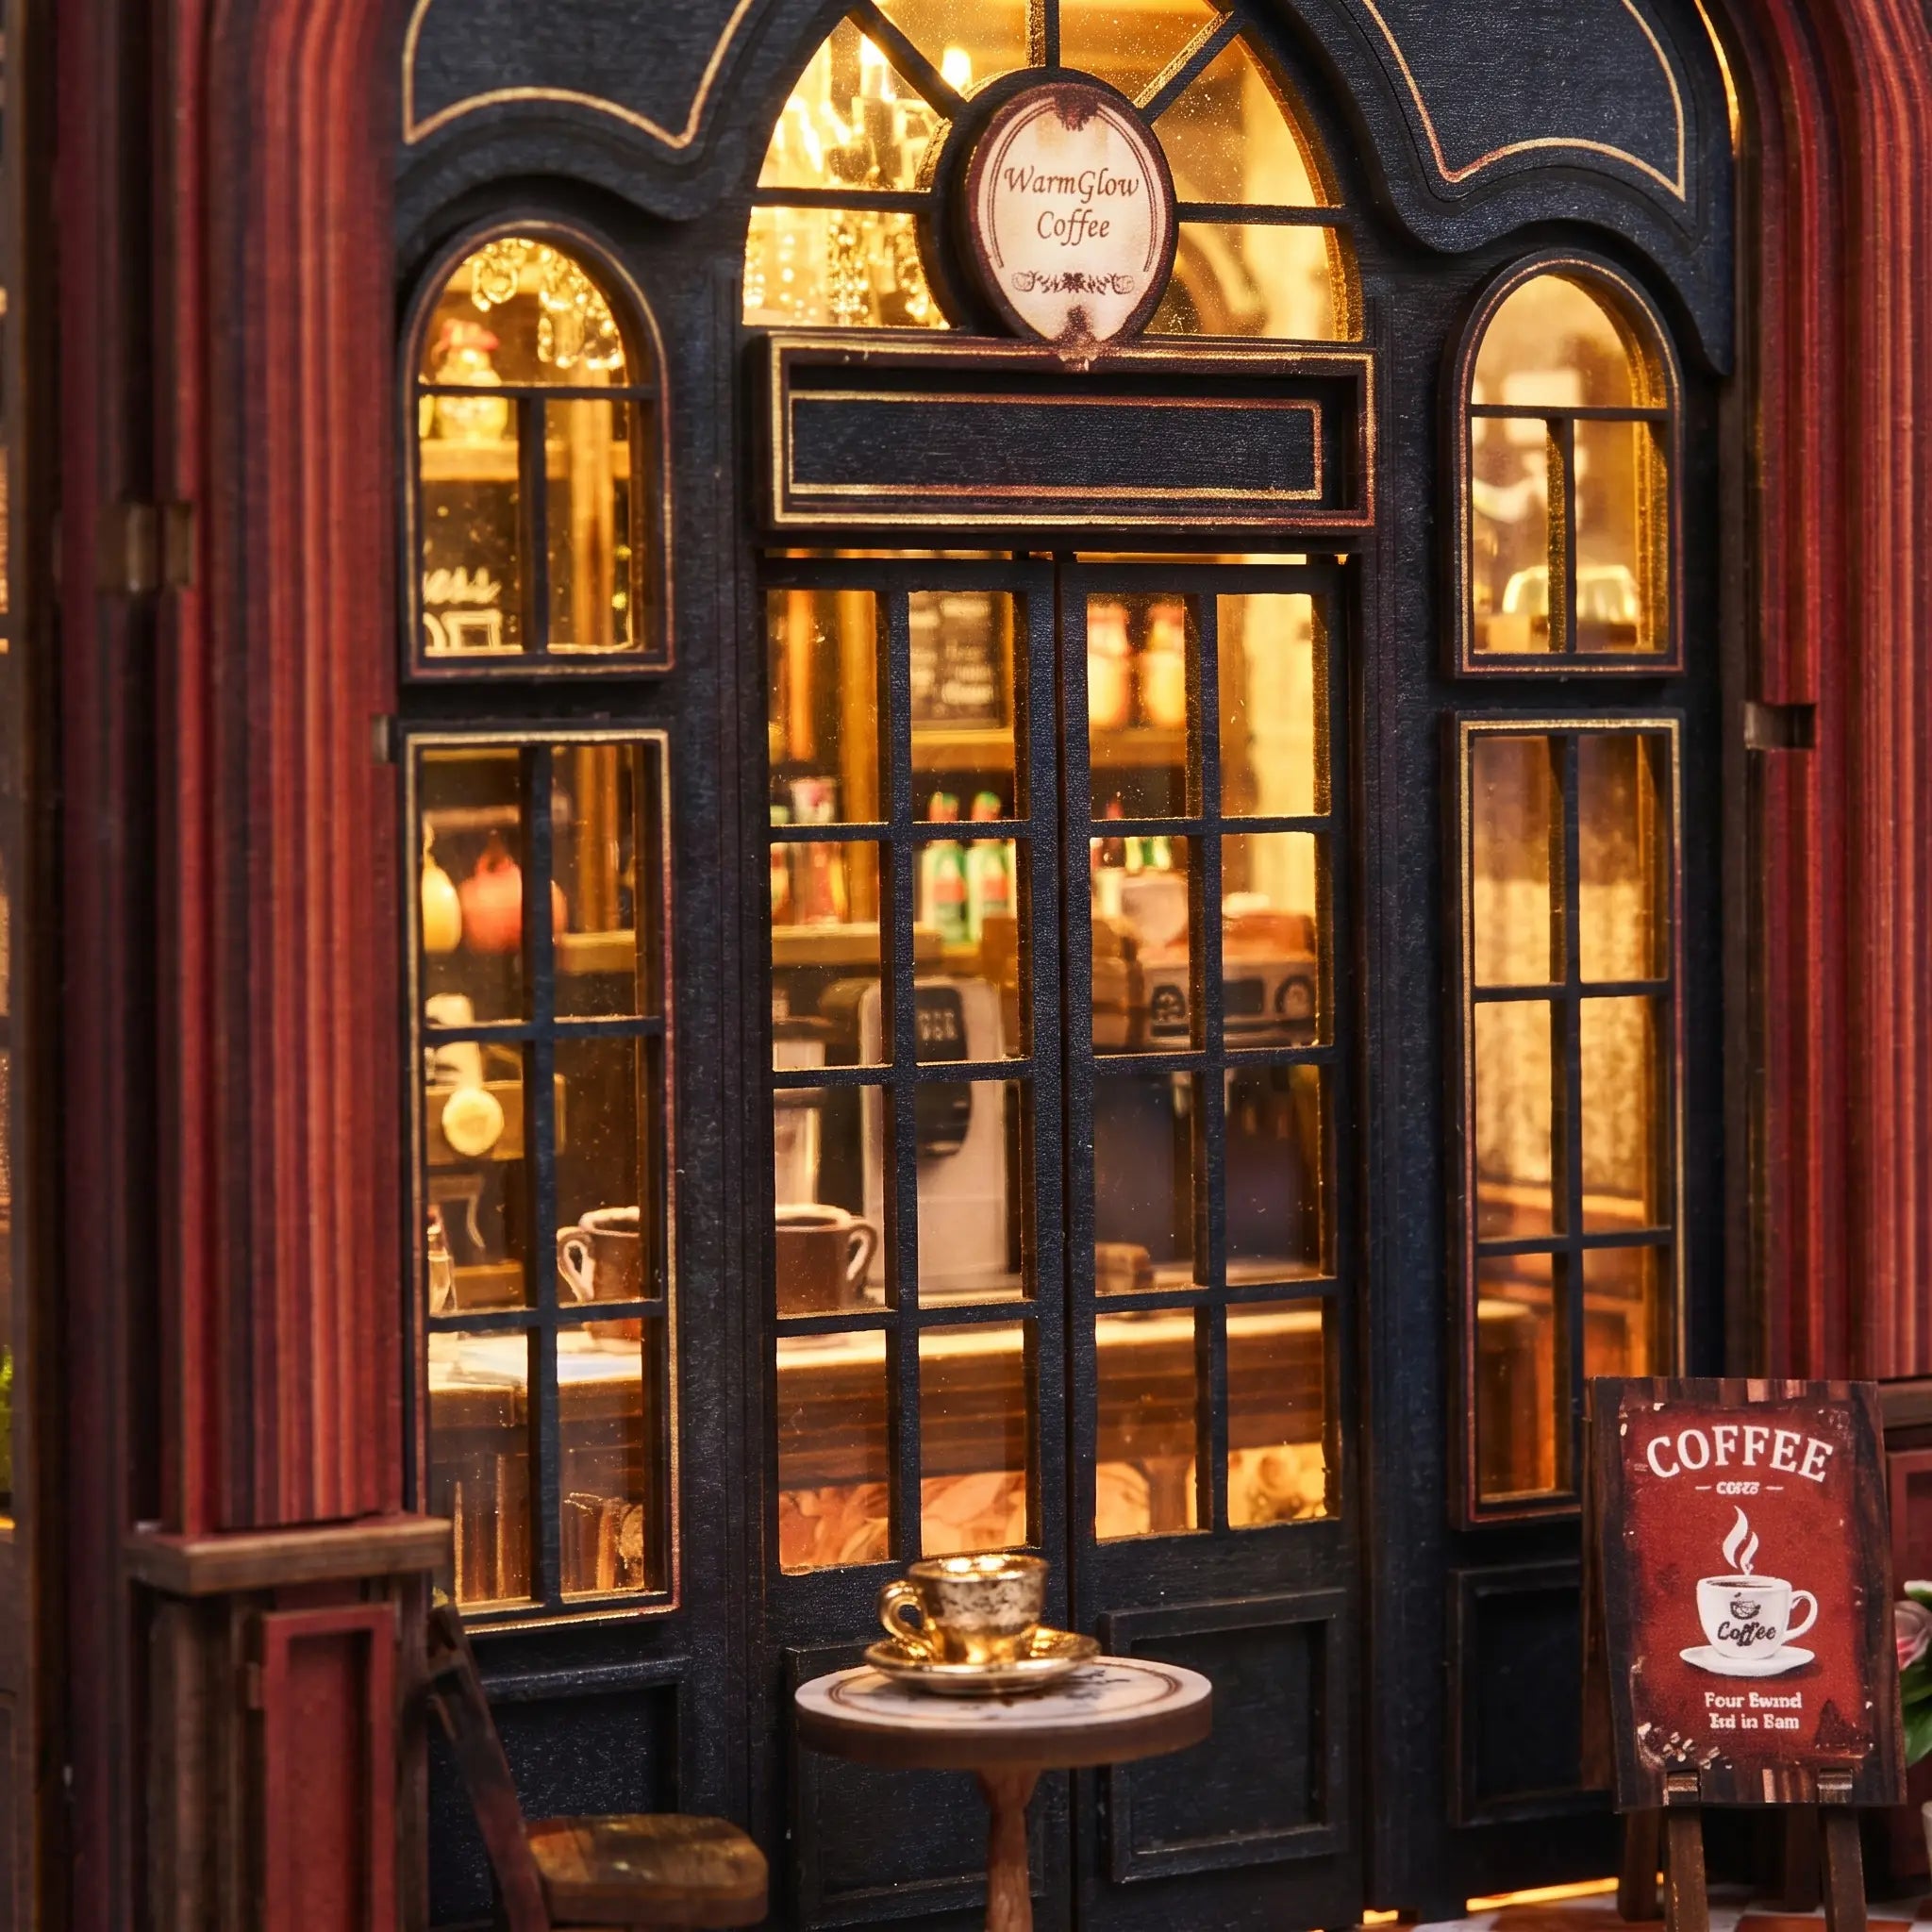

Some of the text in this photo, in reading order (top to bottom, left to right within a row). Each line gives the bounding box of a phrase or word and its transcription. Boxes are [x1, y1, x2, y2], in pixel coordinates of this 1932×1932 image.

[1004, 165, 1140, 204] WarmGlow
[1037, 208, 1110, 246] Coffee
[1646, 1424, 1834, 1483] COFFEE
[1717, 1621, 1776, 1647] Coffee
[1704, 1691, 1745, 1708] Four
